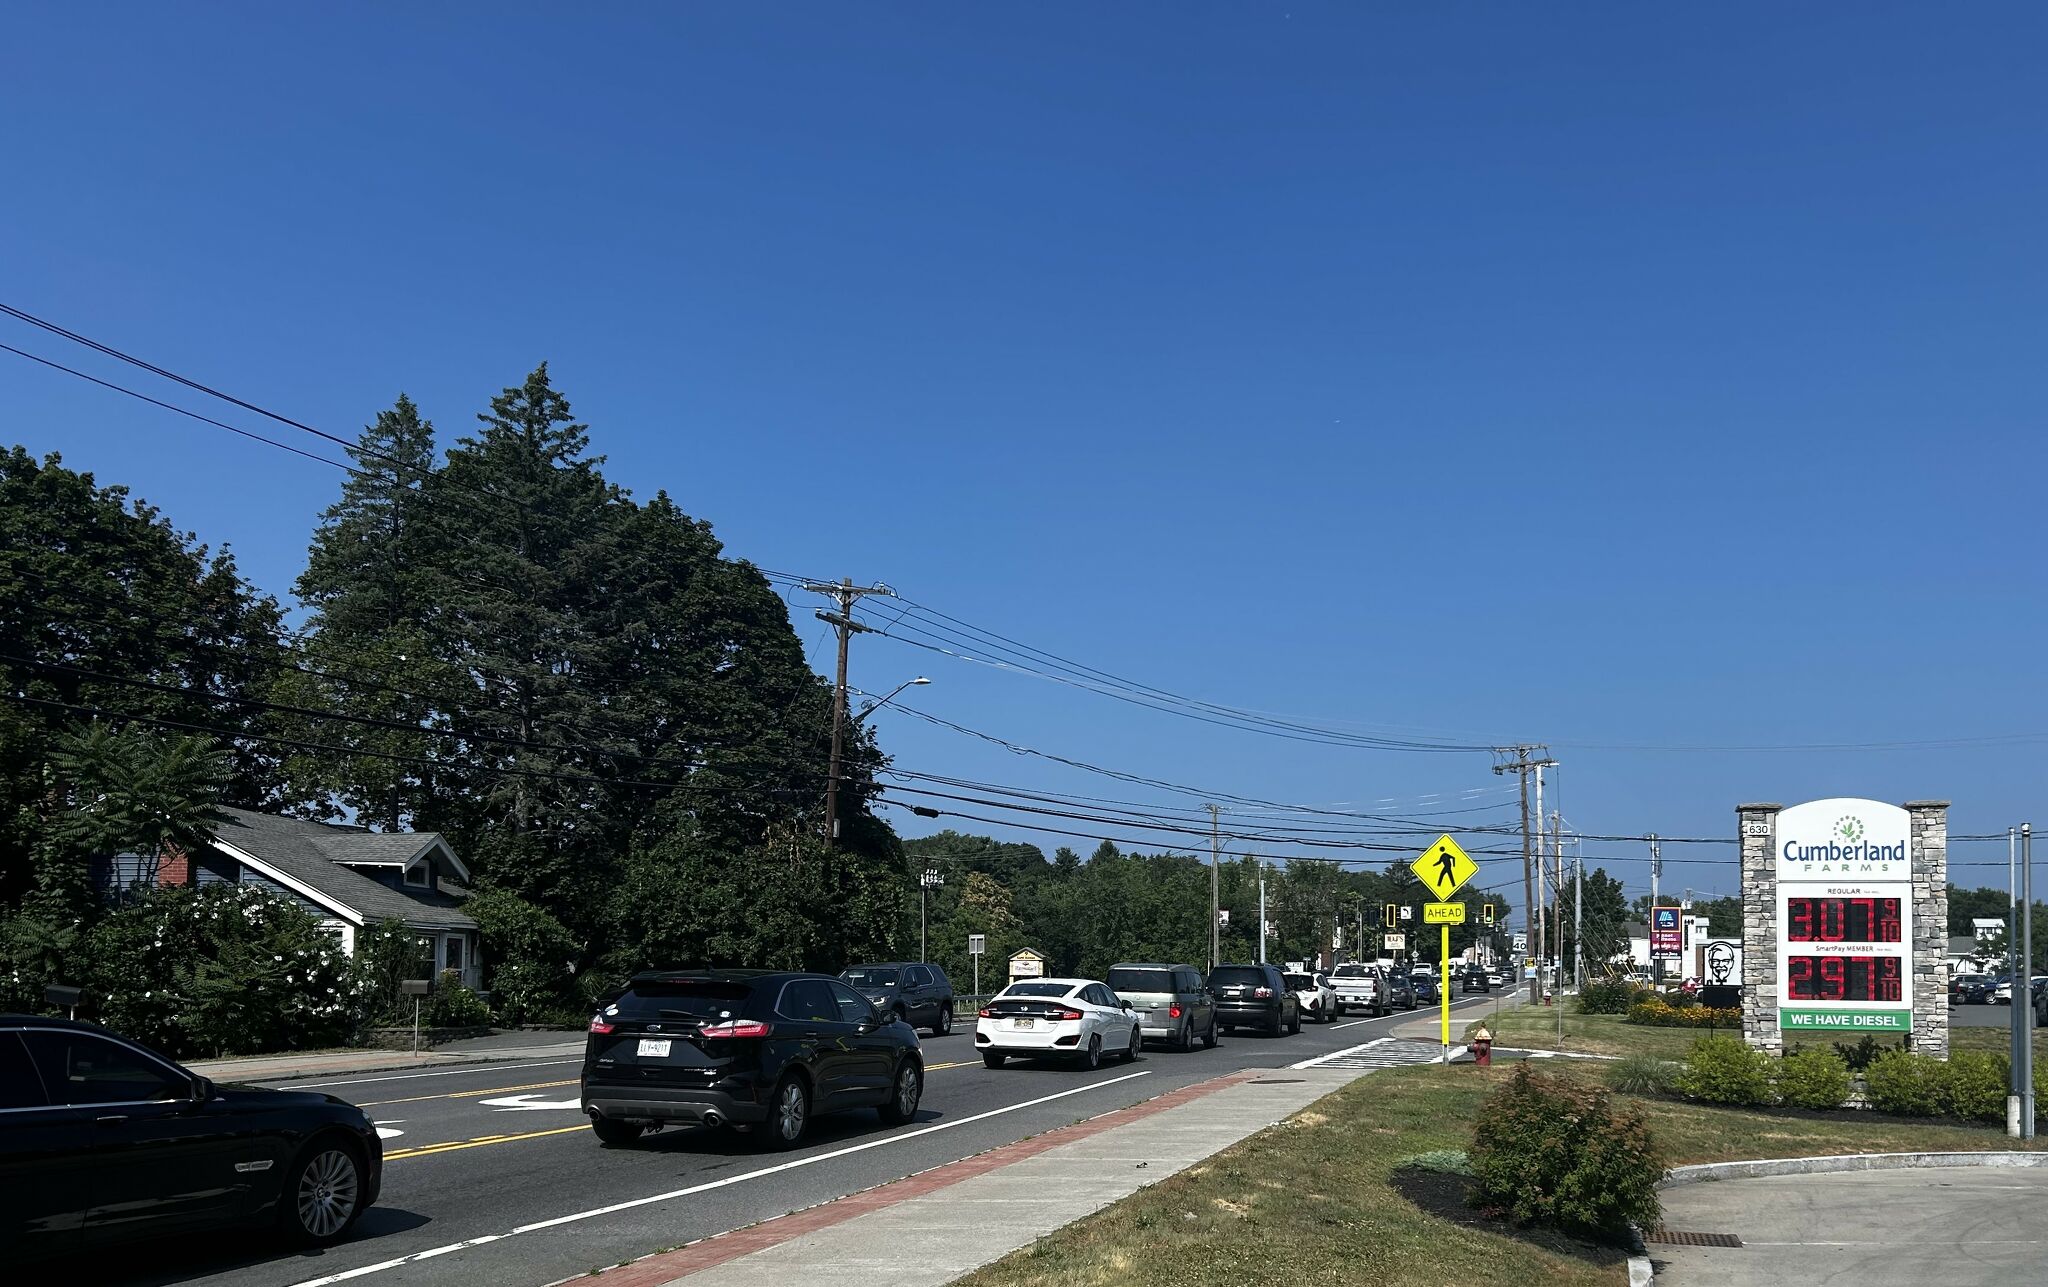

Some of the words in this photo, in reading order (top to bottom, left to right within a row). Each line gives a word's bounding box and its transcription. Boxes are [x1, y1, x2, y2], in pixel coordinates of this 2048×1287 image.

[1749, 825, 1769, 834] 630
[1783, 840, 1905, 862] Cumberland
[1804, 864, 1889, 872] FARMS
[1427, 908, 1462, 918] AHEAD
[1513, 942, 1527, 950] 40
[1815, 945, 1845, 953] SmartPay
[1791, 1014, 1813, 1025] WE
[1815, 1014, 1851, 1026] HAVE
[1853, 1015, 1901, 1027] DIESEL
